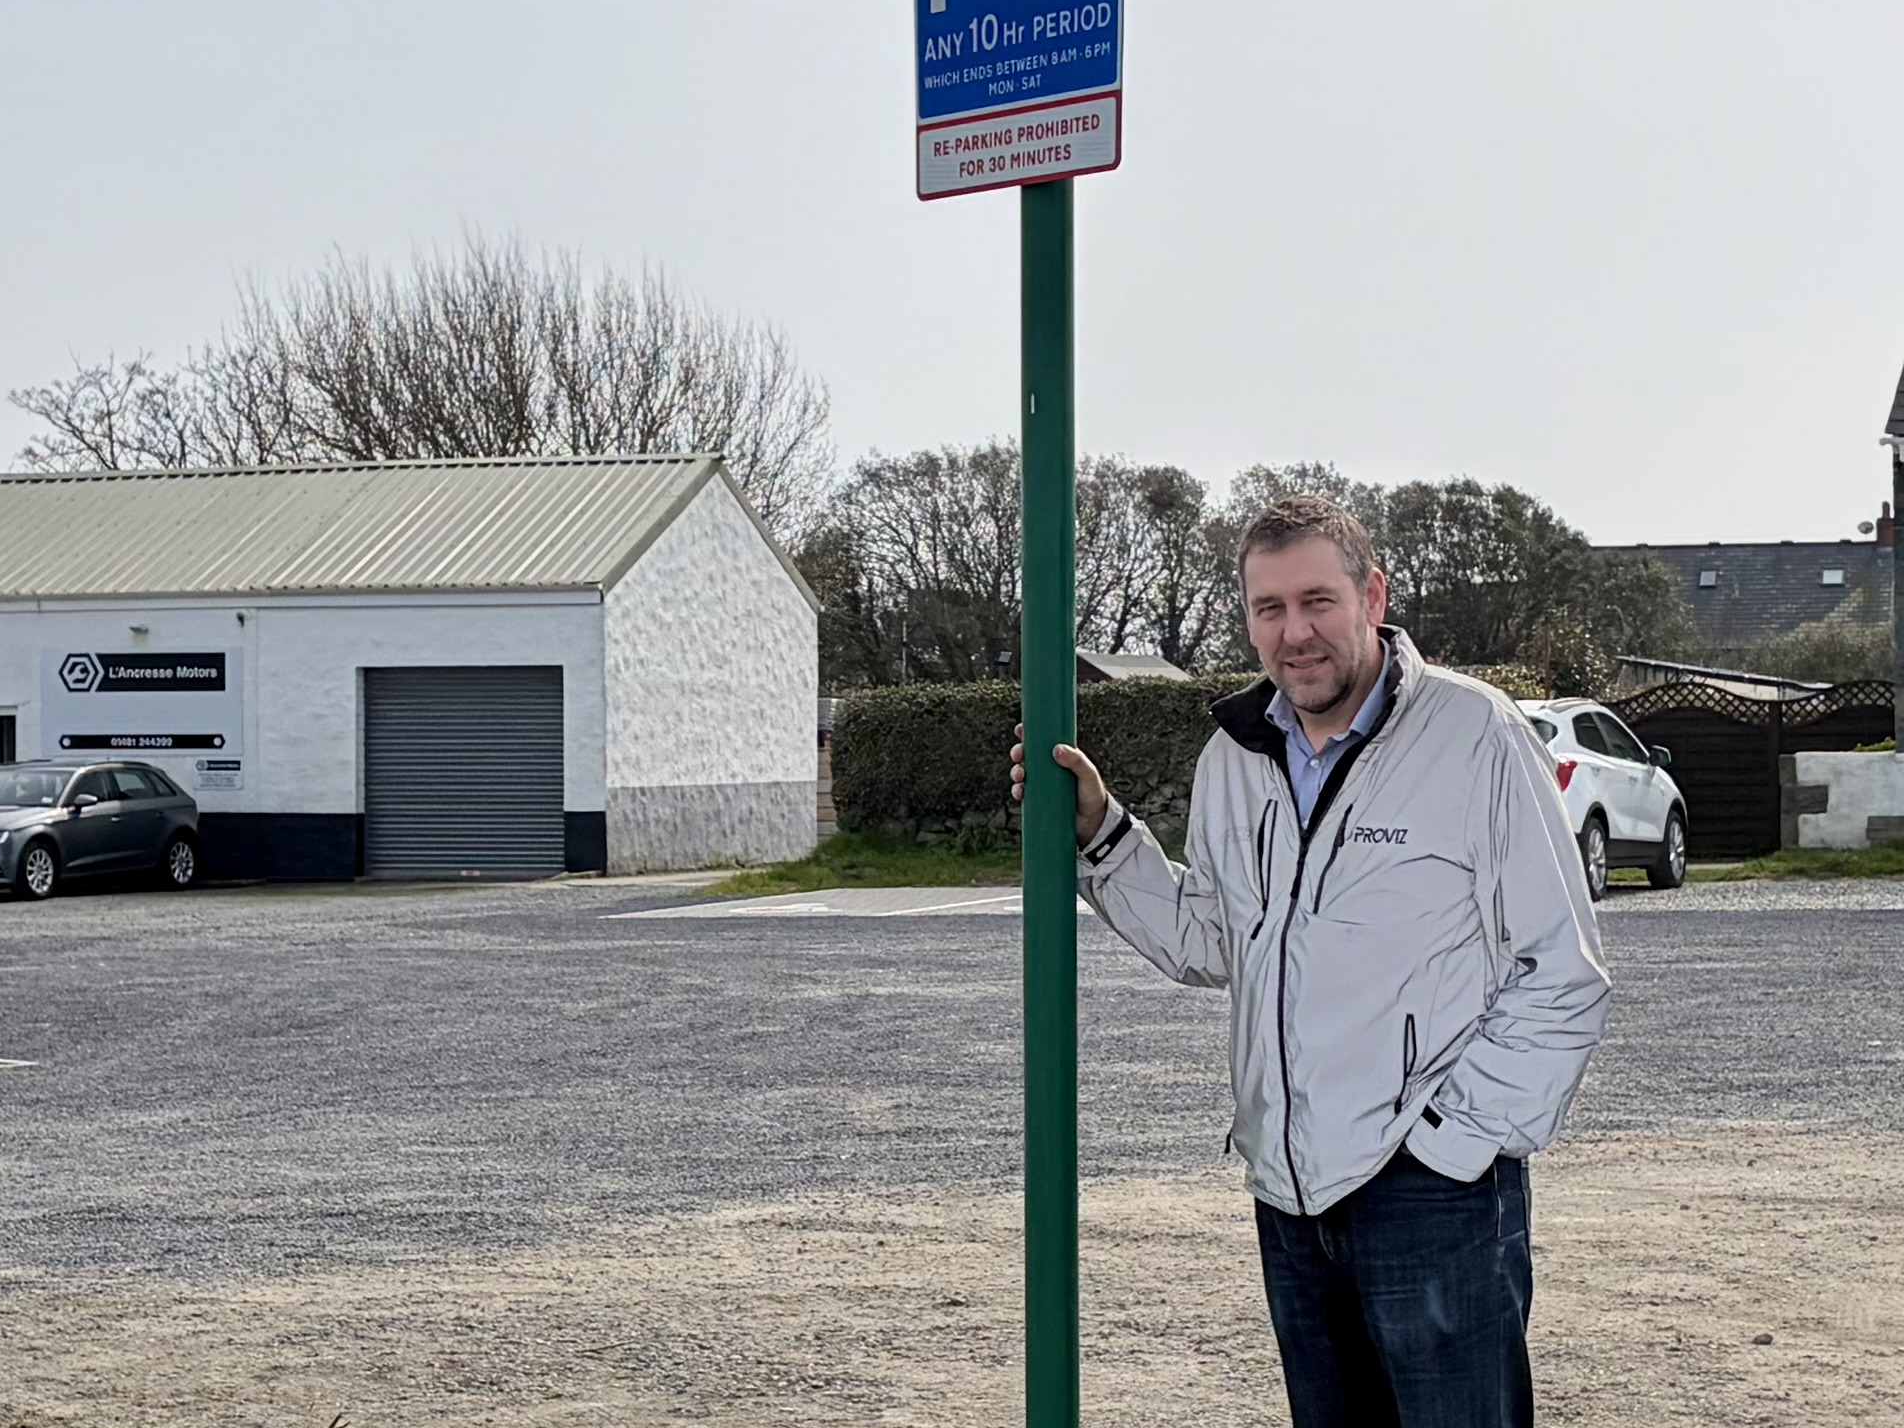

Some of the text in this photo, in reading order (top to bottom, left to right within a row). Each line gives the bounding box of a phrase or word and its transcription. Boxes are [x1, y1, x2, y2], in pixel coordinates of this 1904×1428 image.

[924, 2, 1111, 62] ANY 10 Hr PERIOD
[924, 72, 960, 89] WHICH
[963, 64, 993, 83] ENDS
[996, 54, 1048, 75] BETWEEN
[988, 79, 1015, 96] MON
[1021, 73, 1042, 91] SAT
[933, 113, 1100, 157] RE-PARKING PROHIBITED
[959, 143, 1072, 178] FOR 30 MINUTES
[108, 666, 218, 679] L'Ancresse Motors
[1354, 826, 1408, 845] PROVIZ
